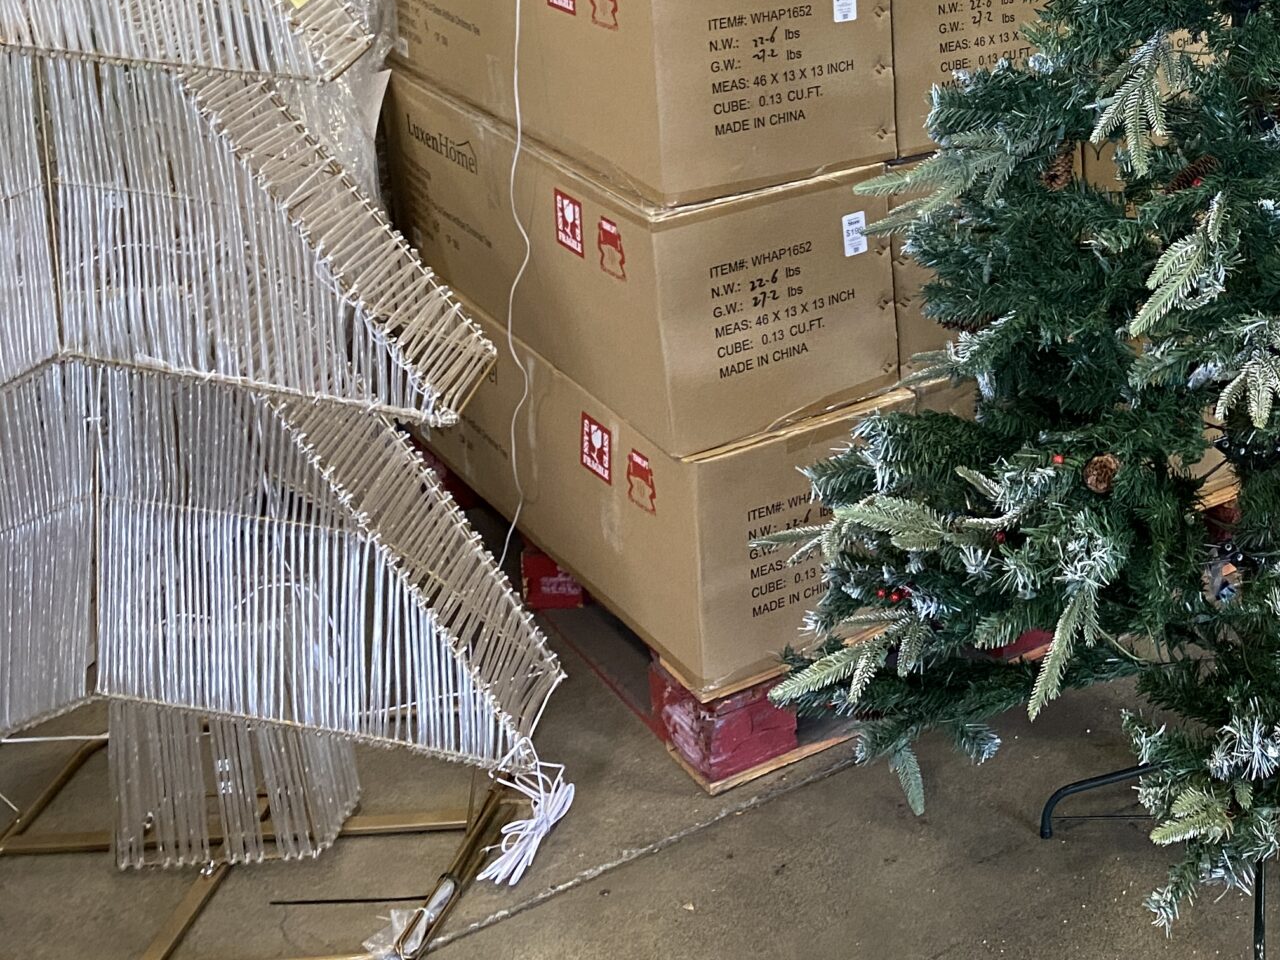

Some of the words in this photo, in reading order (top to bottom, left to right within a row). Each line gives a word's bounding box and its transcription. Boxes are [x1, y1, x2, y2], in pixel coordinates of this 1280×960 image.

[708, 15, 747, 31] ITEM#:
[750, 5, 812, 24] WHAP1652
[1002, 13, 1015, 24] lbs
[784, 29, 800, 41] lbs
[939, 39, 971, 53] MEAS:
[974, 35, 985, 47] 46
[999, 32, 1010, 43] 13
[786, 50, 802, 61] lbs
[940, 58, 972, 73] CUBE:
[712, 78, 749, 94] MEAS:
[753, 75, 767, 87] 46
[783, 70, 796, 82] 13
[811, 65, 824, 77] 13
[827, 59, 855, 74] INCH
[713, 100, 751, 115] CUBE:
[759, 94, 782, 107] 0.13
[715, 119, 750, 136] MADE
[754, 117, 765, 129] IN
[769, 110, 806, 126] CHINA
[709, 258, 749, 279] ITEM#:
[751, 240, 813, 267] WHAP1652
[786, 266, 801, 278] lbs
[787, 285, 803, 298] lbs
[715, 319, 752, 339] MEAS:
[755, 315, 769, 326] 46
[785, 306, 797, 318] 13
[813, 299, 825, 311] 13
[828, 288, 855, 307] INCH
[717, 339, 754, 359] CUBE:
[761, 330, 784, 345] 0.13
[719, 358, 754, 379] MADE
[757, 353, 769, 367] IN
[773, 342, 809, 362] CHINA
[747, 502, 785, 522] ITEM#:
[750, 560, 787, 580] MEAS:
[751, 579, 786, 599] CUBE:
[794, 567, 816, 583] 0.13
[752, 597, 785, 618] MADE
[789, 593, 800, 604] IN
[803, 581, 830, 599] CHIN
